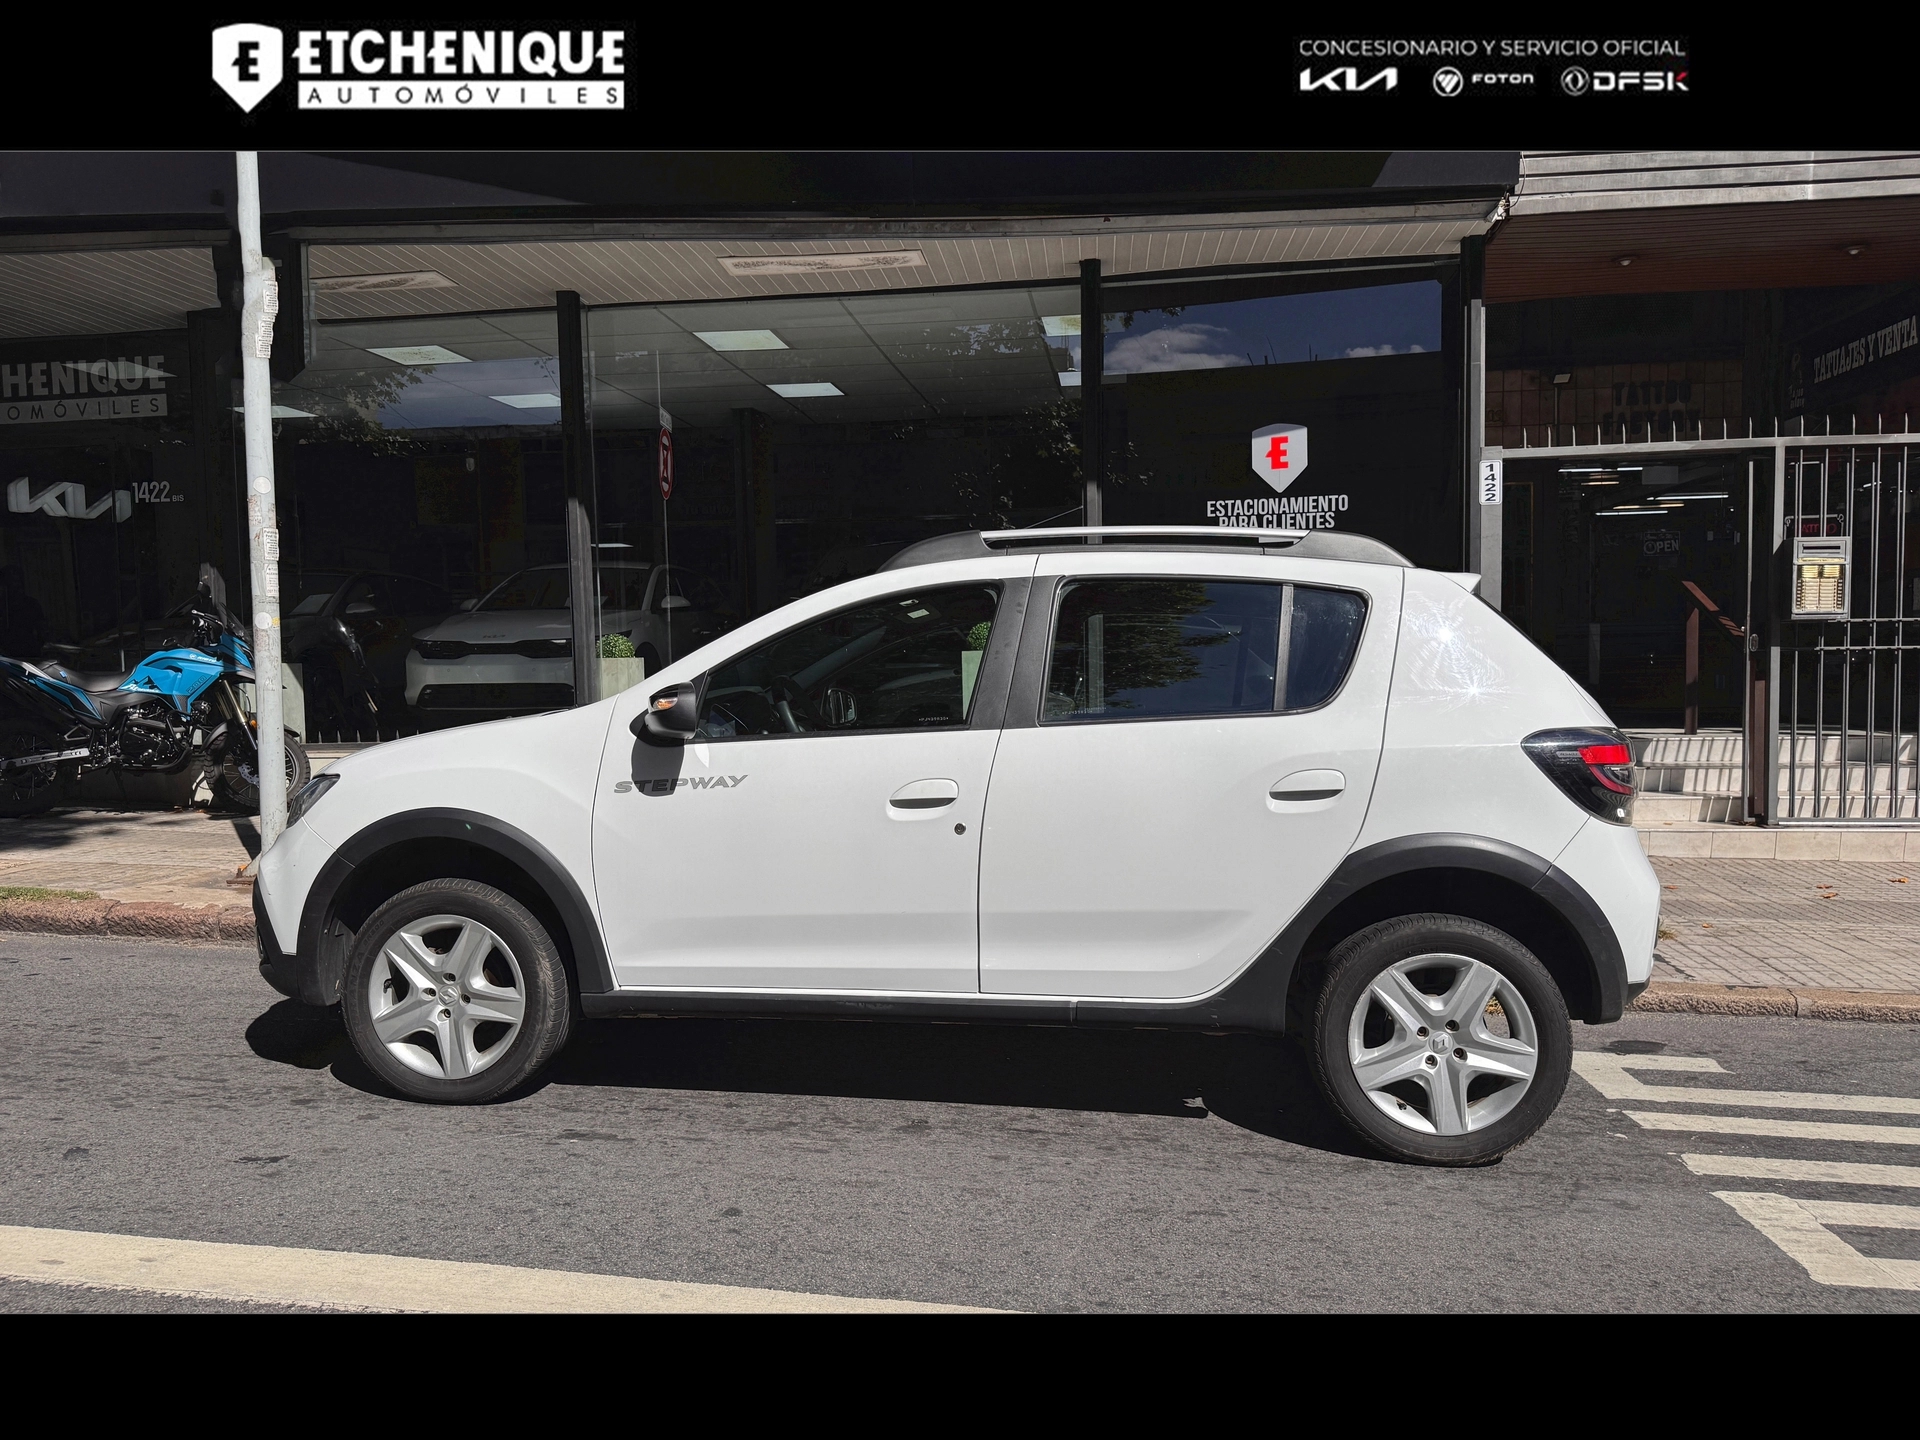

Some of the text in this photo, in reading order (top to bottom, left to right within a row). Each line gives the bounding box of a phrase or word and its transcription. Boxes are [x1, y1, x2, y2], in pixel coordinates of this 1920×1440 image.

[1814, 315, 1919, 384] TATUAJES Y VENTA
[1613, 379, 1691, 406] TATTOO
[132, 481, 170, 503] 1422
[1484, 463, 1497, 502] 1422
[7, 476, 133, 524] KIA
[1207, 495, 1349, 517] ESTACIONAMIENTO
[1219, 512, 1335, 529] PARA CLIENTES
[1643, 539, 1680, 554] OPEN
[613, 774, 749, 794] STEPWAY
